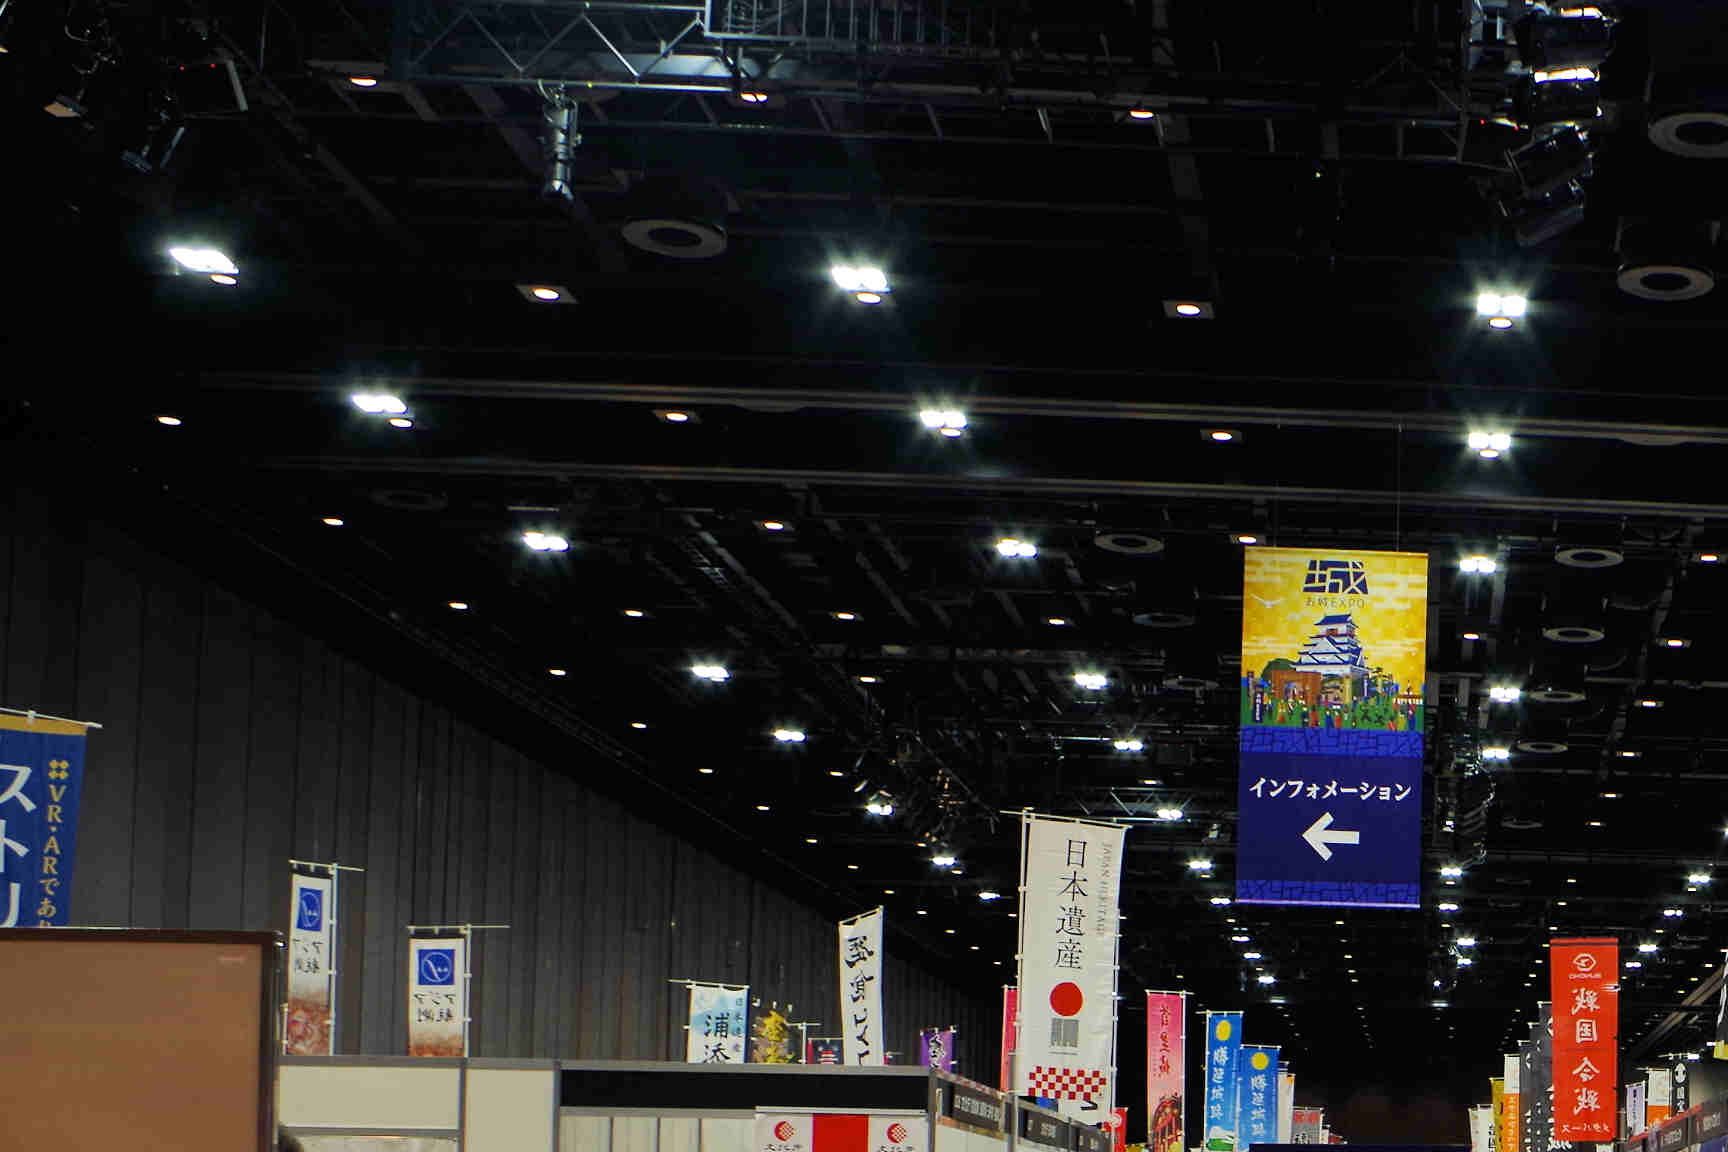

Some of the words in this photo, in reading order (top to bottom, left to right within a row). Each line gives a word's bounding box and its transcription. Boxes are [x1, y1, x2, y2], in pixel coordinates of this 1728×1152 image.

[1249, 778, 1412, 801] インフォメーション
[1055, 839, 1088, 970] 日本遺産
